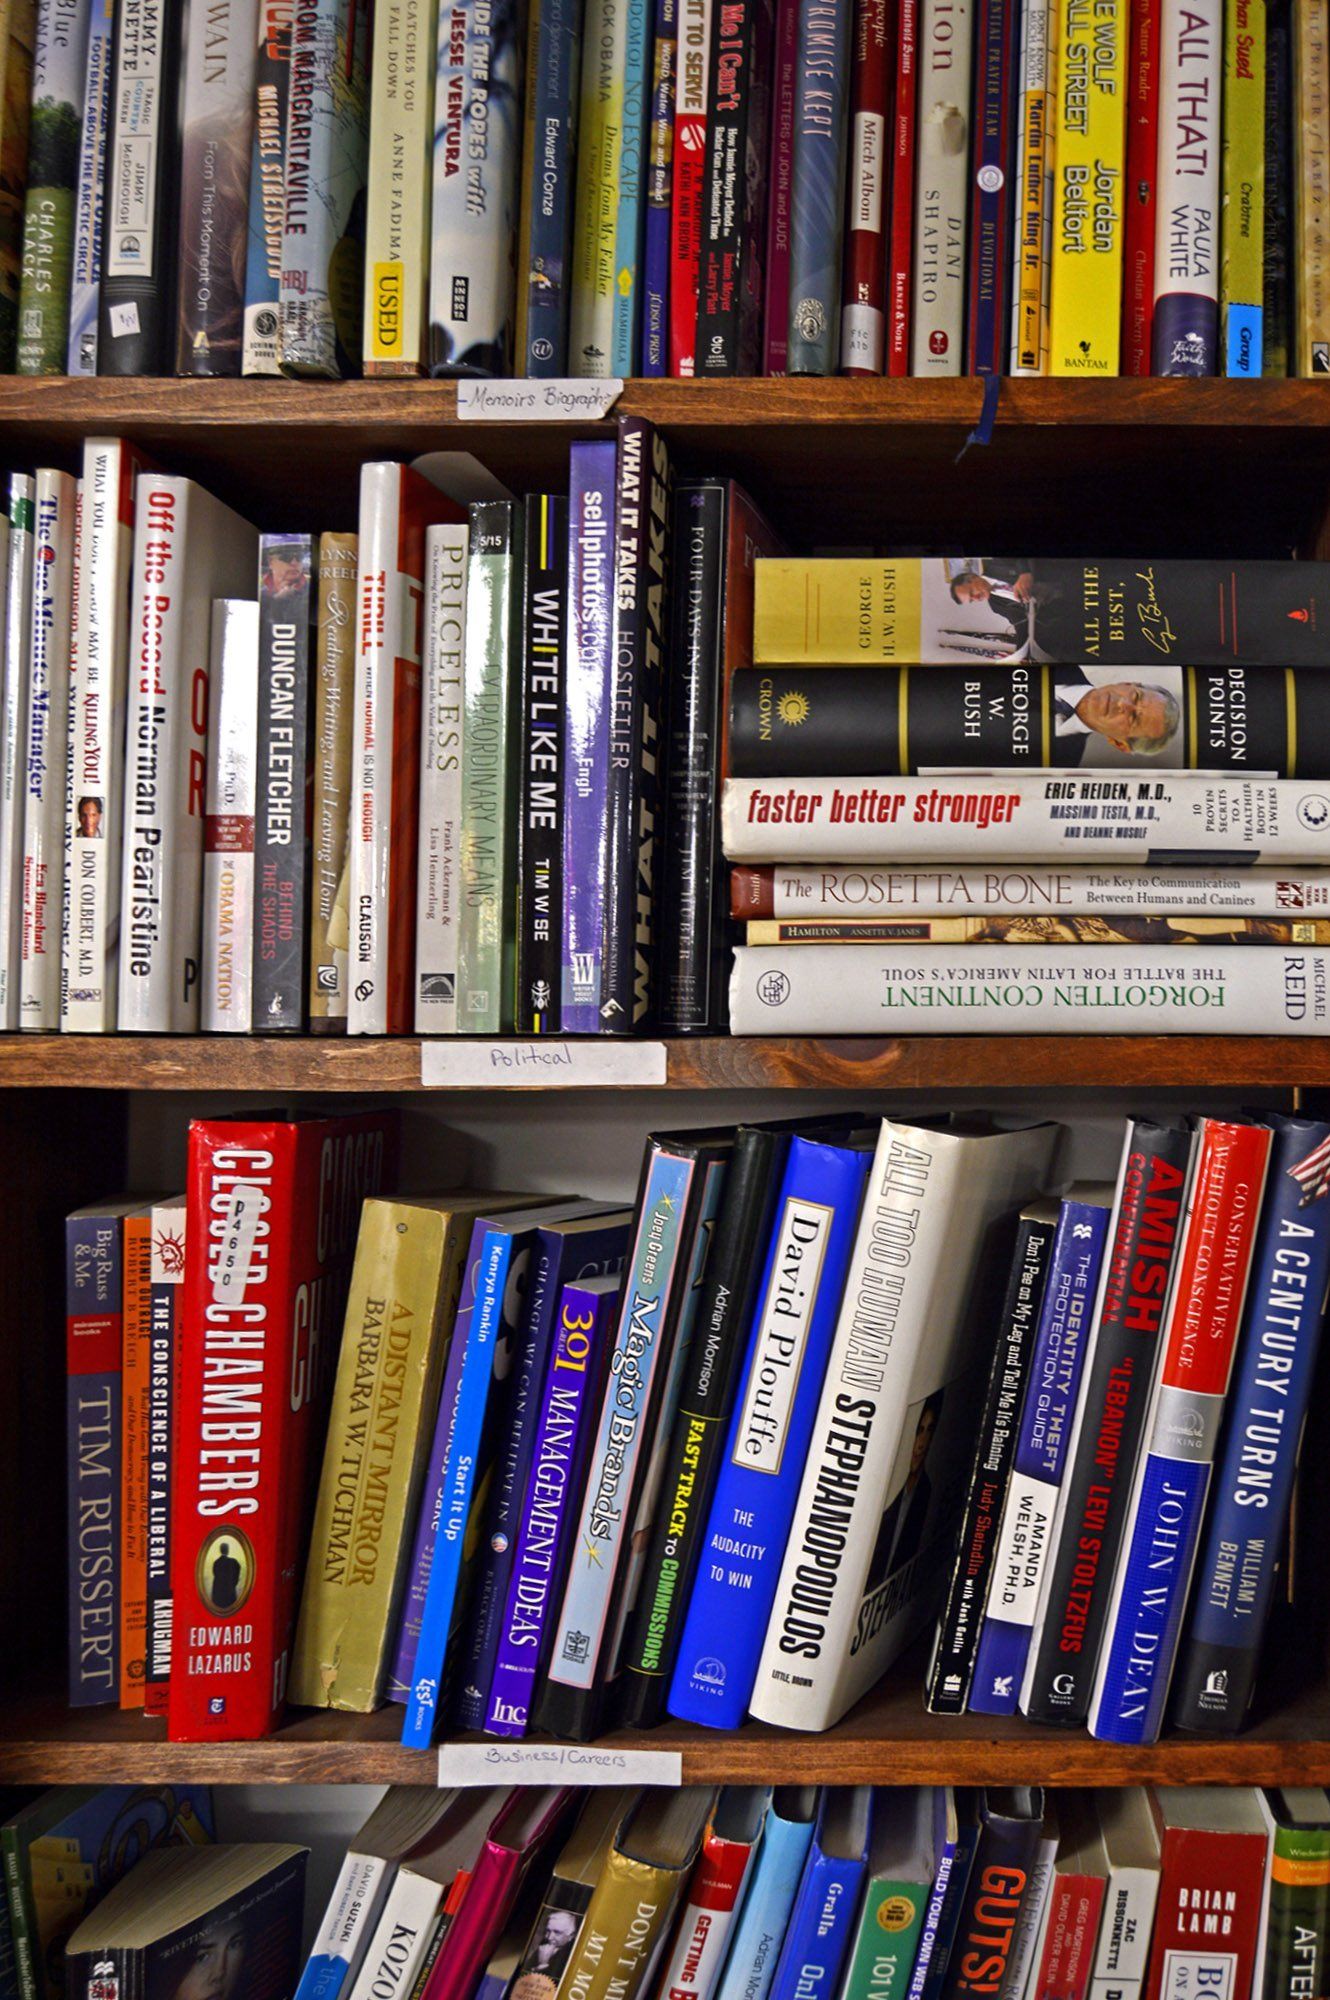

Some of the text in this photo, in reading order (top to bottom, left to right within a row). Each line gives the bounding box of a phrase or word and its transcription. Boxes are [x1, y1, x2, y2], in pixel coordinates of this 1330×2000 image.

[386, 5, 401, 99] FALL DOWN
[684, 22, 704, 109] TO SERVE
[716, 3, 745, 112] Me I Can't
[1093, 22, 1117, 95] WOLF
[444, 8, 467, 178] JESSE VENTURA
[802, 90, 832, 138] KEPT
[1065, 43, 1089, 135] STREET
[1175, 9, 1210, 176] ALL THAT!
[76, 36, 102, 285] FOOTBALL ABOVE THE ARCTIC CIRCLE
[133, 162, 146, 204] JIMMY
[543, 117, 560, 216] Edward Conze
[860, 119, 878, 222] Mitch Albom
[198, 141, 219, 311] From This Moment On
[1063, 165, 1089, 254] Belfort
[1093, 159, 1120, 252] Jordan
[1170, 204, 1190, 278] WHITE
[1192, 207, 1212, 277] PAULA
[1239, 182, 1253, 238] Crabtree
[23, 213, 38, 278] SLACK
[35, 200, 57, 293] CHARLES
[922, 189, 941, 304] SHAPIRO
[945, 216, 963, 280] DANI
[377, 274, 398, 347] USED
[1064, 357, 1108, 369] BANTAM
[1237, 326, 1253, 371] Group
[858, 577, 872, 649] GEORGE
[1084, 566, 1100, 657] ALL THE
[437, 544, 464, 772] PRICELESS
[267, 622, 297, 846] DUNCAN FLETCHER
[529, 588, 560, 830] WHITE LIKE ME
[760, 678, 773, 742] CROWN
[964, 682, 981, 738] BUSH
[1012, 669, 1029, 755] GEORGE
[1208, 677, 1226, 748] POINTS
[1228, 668, 1246, 760] DECISION
[747, 789, 1021, 829] faster better stronger
[1205, 790, 1215, 832] PROVEN
[1218, 789, 1227, 833] SECRETS
[217, 871, 236, 937] OBAMA
[426, 827, 440, 920] Lisa Heinzerling
[750, 874, 760, 905] Smith
[782, 873, 1072, 905] The ROSETTA BONE
[1086, 892, 1256, 906] Between Humans and Canines
[1087, 876, 1241, 890] The Key to Communication
[261, 862, 278, 960] THE SHADES
[278, 881, 294, 941] BEHIND
[358, 895, 372, 962] CLAUSON
[216, 942, 234, 1012] NATION
[881, 986, 1225, 1007] FORGOTTEN CONTINENT
[882, 968, 1226, 980] THE BATTLE FOR LATIN AMERICA'S SOUL
[1284, 957, 1306, 1021] REID
[1313, 958, 1325, 1020] MICHAEL
[490, 1044, 572, 1067] Political
[74, 1243, 90, 1288] & Me
[1101, 1152, 1146, 1325] CONFIDENTIAL
[1125, 1156, 1183, 1332] AMISH
[1209, 1183, 1249, 1339] CONSERVATIVES
[555, 1304, 593, 1372] 301
[696, 1284, 732, 1397] Adrian Morrison
[745, 1214, 822, 1455] David Plouffe
[1030, 1273, 1073, 1449] PROTECTION GUIDE
[1233, 1219, 1315, 1508] A CENTURY TURNS
[150, 1296, 170, 1578] THE CONSCIENCE OF A LIBERAL
[589, 1291, 660, 1540] Magic Brands
[444, 1456, 472, 1542] Start It Up
[522, 1387, 579, 1573] MANAGEMENT
[79, 1386, 113, 1688] TIM RUSSERT
[641, 1420, 705, 1669] FAST TRACK TO COMMISSIONS
[711, 1534, 766, 1561] AUDACITY
[733, 1508, 755, 1528] THE
[779, 1392, 877, 1660] STEPHANOPOULOS
[1022, 1512, 1048, 1588] AMANDA
[509, 1575, 548, 1648] IDEAS
[710, 1565, 752, 1589] TO WIN
[1209, 1541, 1239, 1609] BENNETT
[153, 1598, 174, 1676] KRUGMAN
[189, 1653, 251, 1675] LAZARUS
[190, 1625, 252, 1647] EDWARD
[484, 1747, 627, 1768] Business/Careers
[339, 1864, 377, 1943] DAVID SUZUKI
[618, 1901, 658, 1971] DON'T
[816, 1882, 845, 1937] Gralla
[911, 1857, 954, 1993] BUILD YOUR OWN WEB
[958, 1864, 1028, 1994] GUTS!
[1107, 1890, 1129, 1970] BISSONNETTE
[1124, 1919, 1137, 1943] ZAC
[1177, 1913, 1233, 1936] LAMB
[1178, 1888, 1237, 1911] BRIAN
[680, 1914, 714, 1983] GETTING
[751, 1934, 775, 1973] Adrian
[868, 1954, 899, 1986] 101
